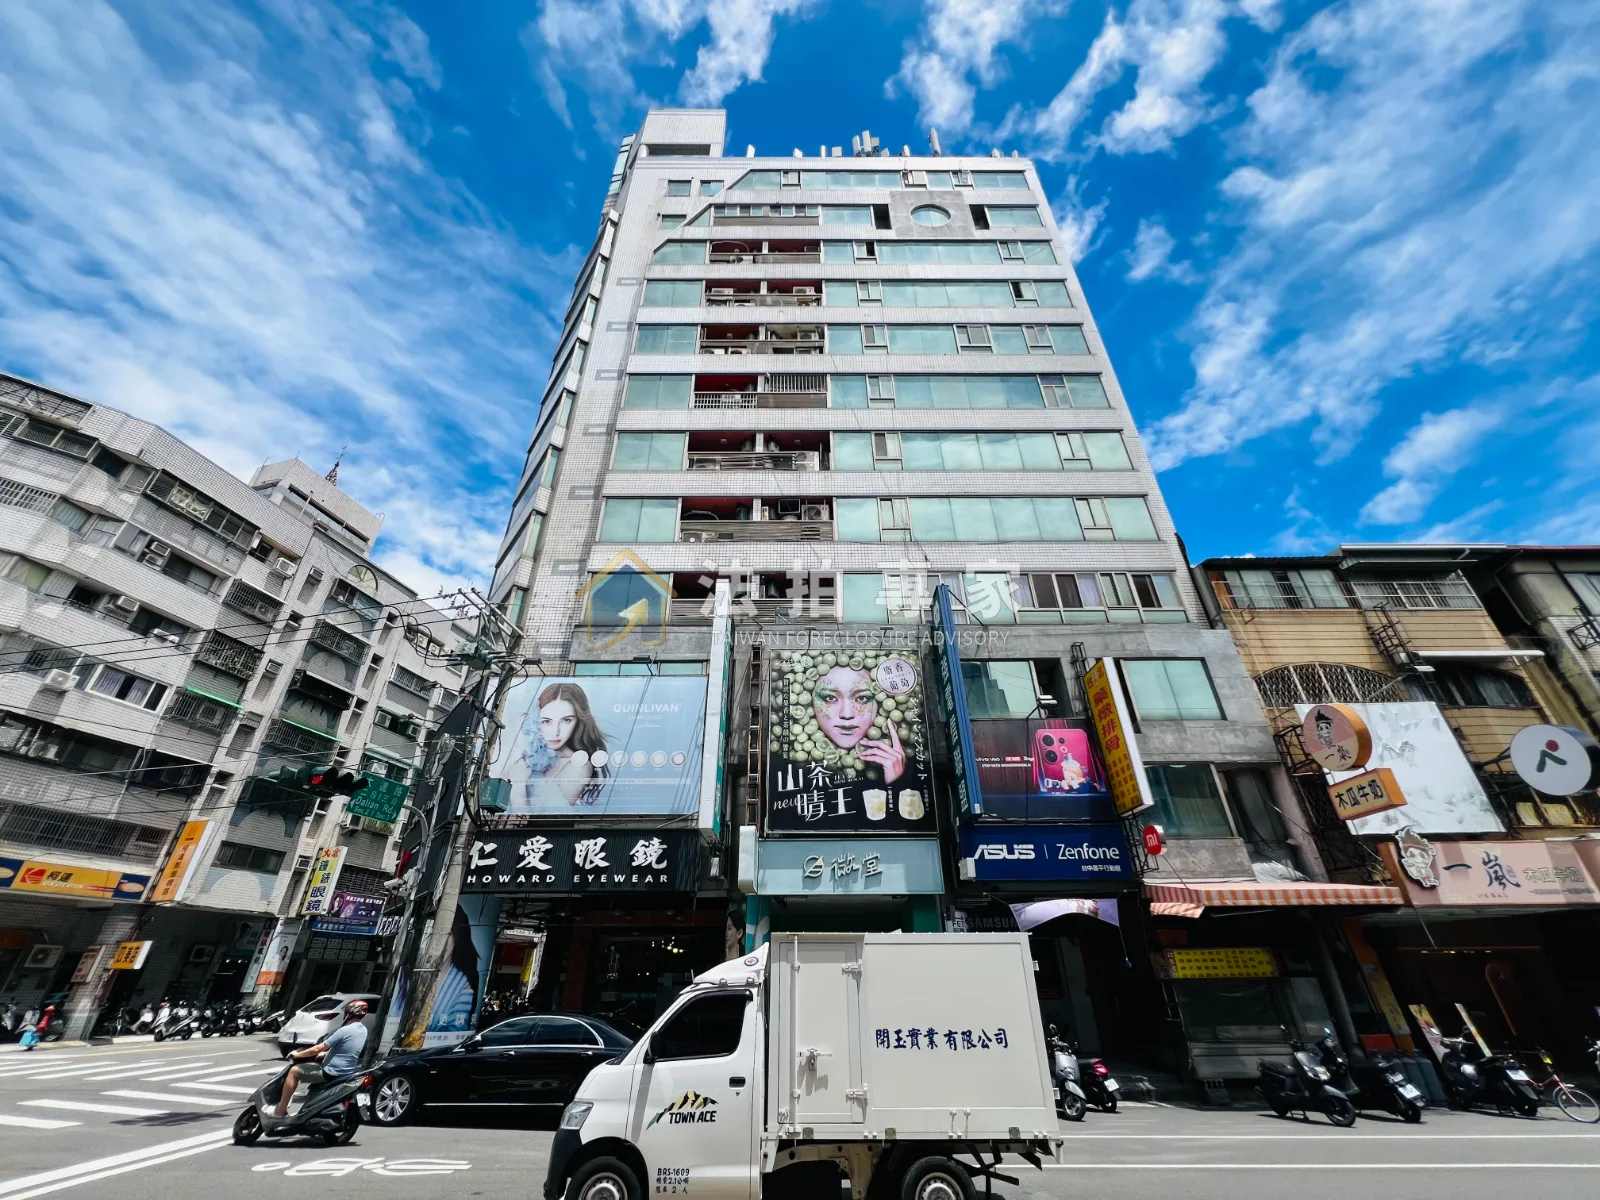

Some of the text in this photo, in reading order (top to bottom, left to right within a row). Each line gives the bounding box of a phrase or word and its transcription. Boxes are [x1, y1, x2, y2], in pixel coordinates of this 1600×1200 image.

[613, 703, 679, 713] QUINLIVAN
[778, 760, 834, 791] 山茶
[1335, 779, 1384, 810] 木瓜牛奶
[470, 835, 668, 870] 仁愛眼鏡
[974, 842, 1120, 860] ASUS Zenfone
[47, 870, 73, 882] 柯達
[466, 874, 668, 884] HOWARD EYEWEAR
[1522, 867, 1585, 883] 木瓜牛奶
[42, 880, 84, 889] express
[669, 1110, 717, 1124] TOWN ACE
[657, 1167, 690, 1177] BRS-1609
